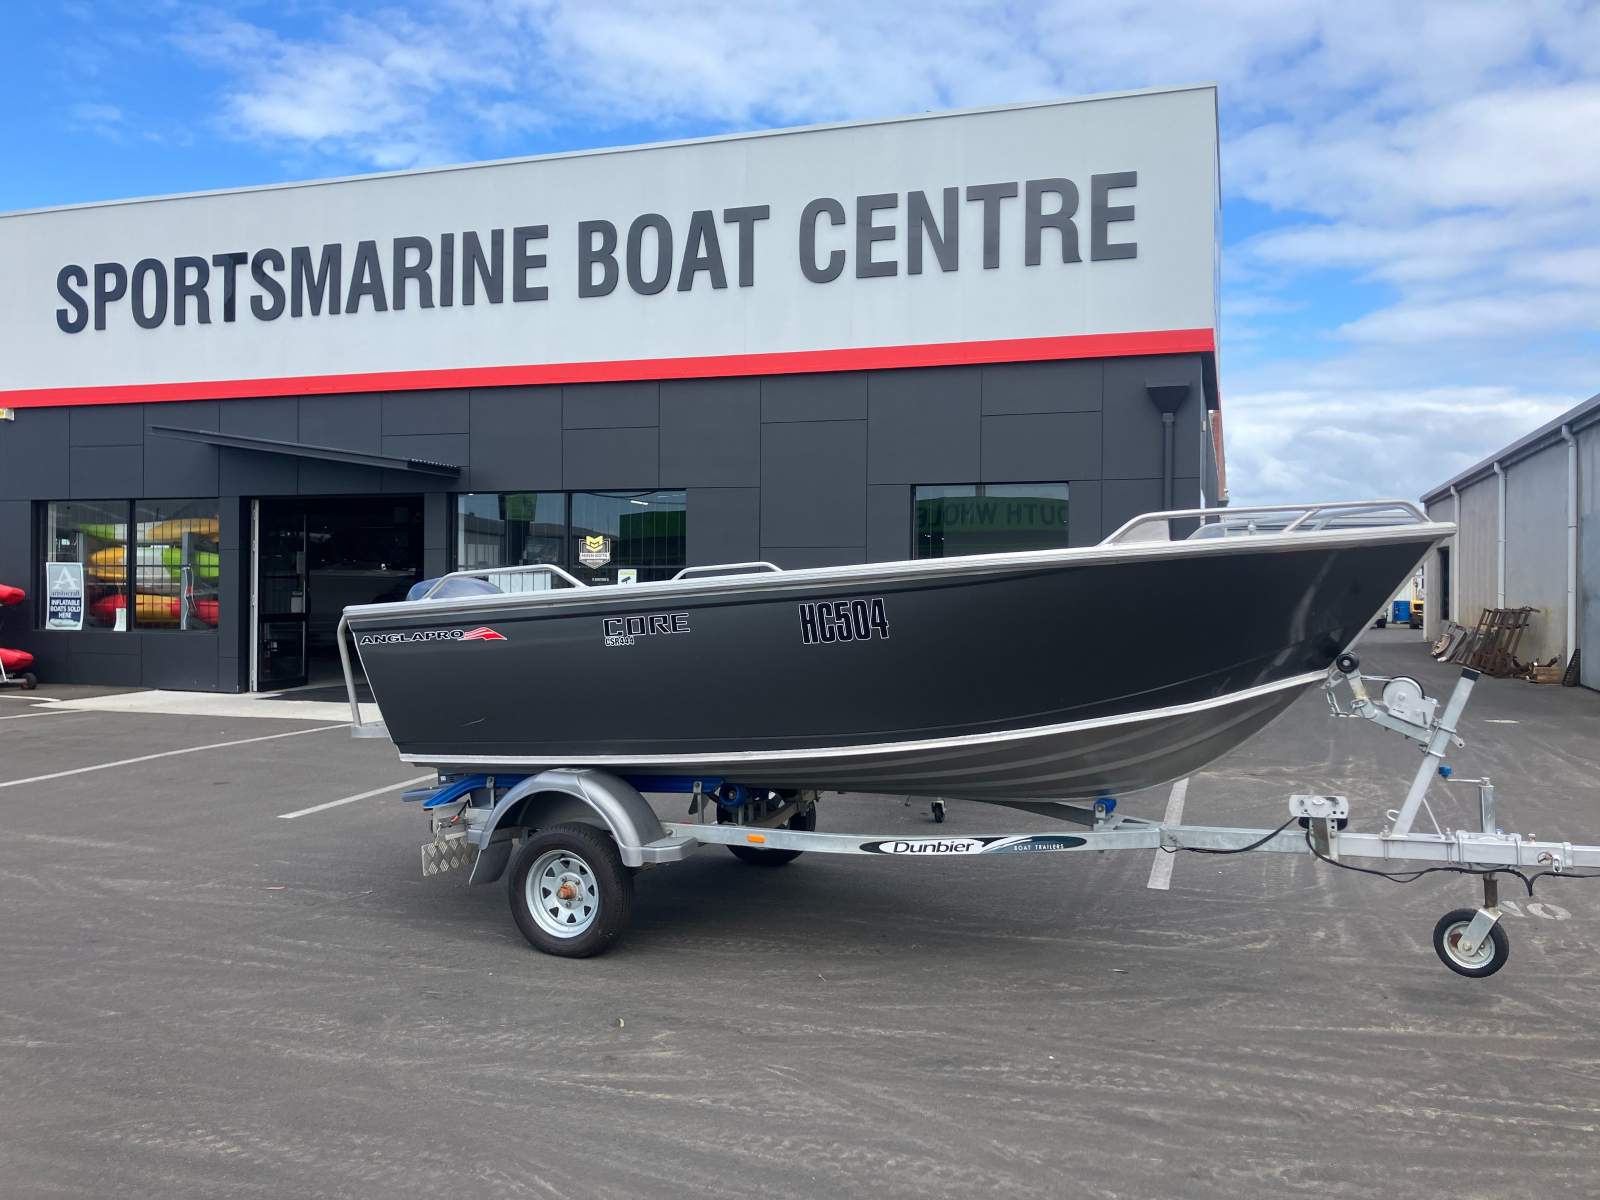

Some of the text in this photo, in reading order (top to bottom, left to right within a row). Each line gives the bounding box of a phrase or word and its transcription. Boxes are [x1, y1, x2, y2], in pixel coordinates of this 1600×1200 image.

[56, 170, 1138, 334] SPORTSMARINE BOAT CENTRE
[603, 613, 690, 637] CORE
[799, 598, 889, 644] HC504
[360, 629, 464, 645] ANGLAPRO
[605, 636, 635, 646] CSR444
[893, 841, 974, 853] Dunbier
[1034, 843, 1064, 851] TRAILERS
